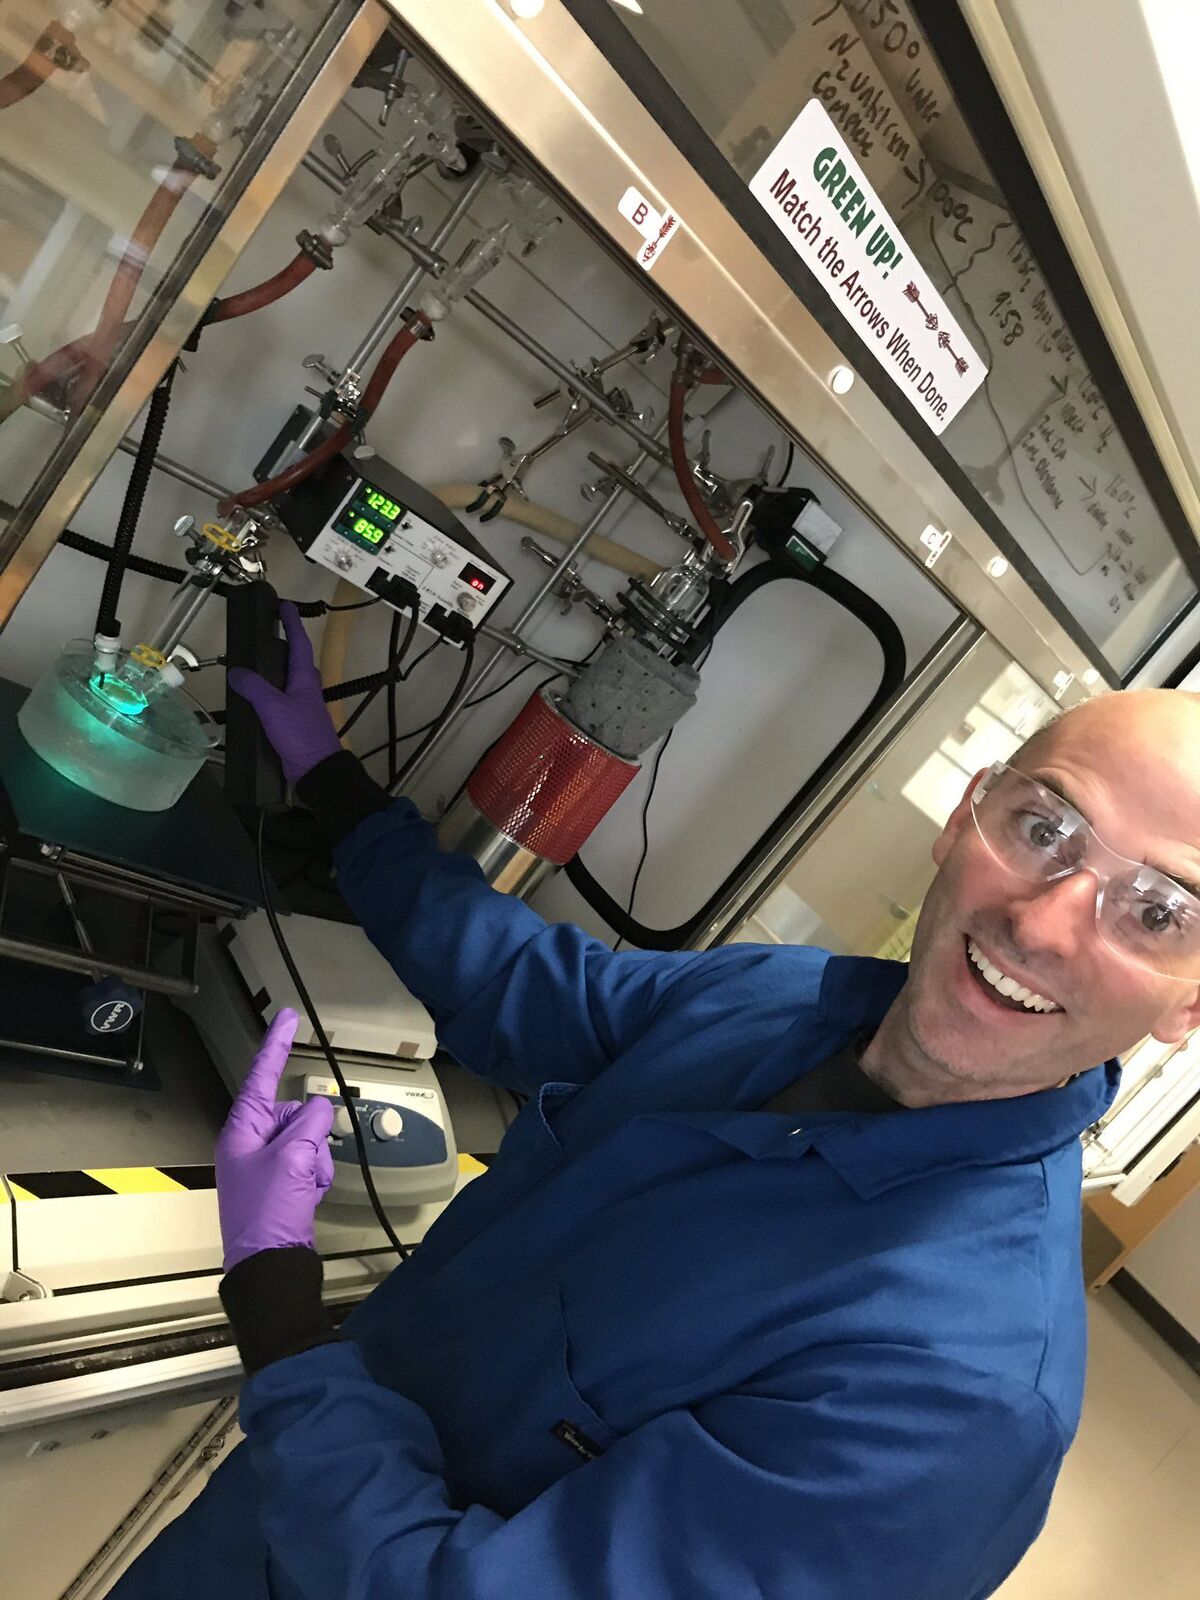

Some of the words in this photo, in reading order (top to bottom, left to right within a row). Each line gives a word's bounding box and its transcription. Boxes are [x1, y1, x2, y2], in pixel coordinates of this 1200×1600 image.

[632, 202, 648, 225] B
[813, 146, 875, 239] GREEN
[865, 224, 903, 280] UP!
[769, 168, 824, 247] Match
[817, 235, 845, 278] the
[839, 271, 889, 338] Arrows
[886, 327, 921, 383] When
[918, 370, 948, 421] Done.
[100, 1003, 125, 1029] VWR
